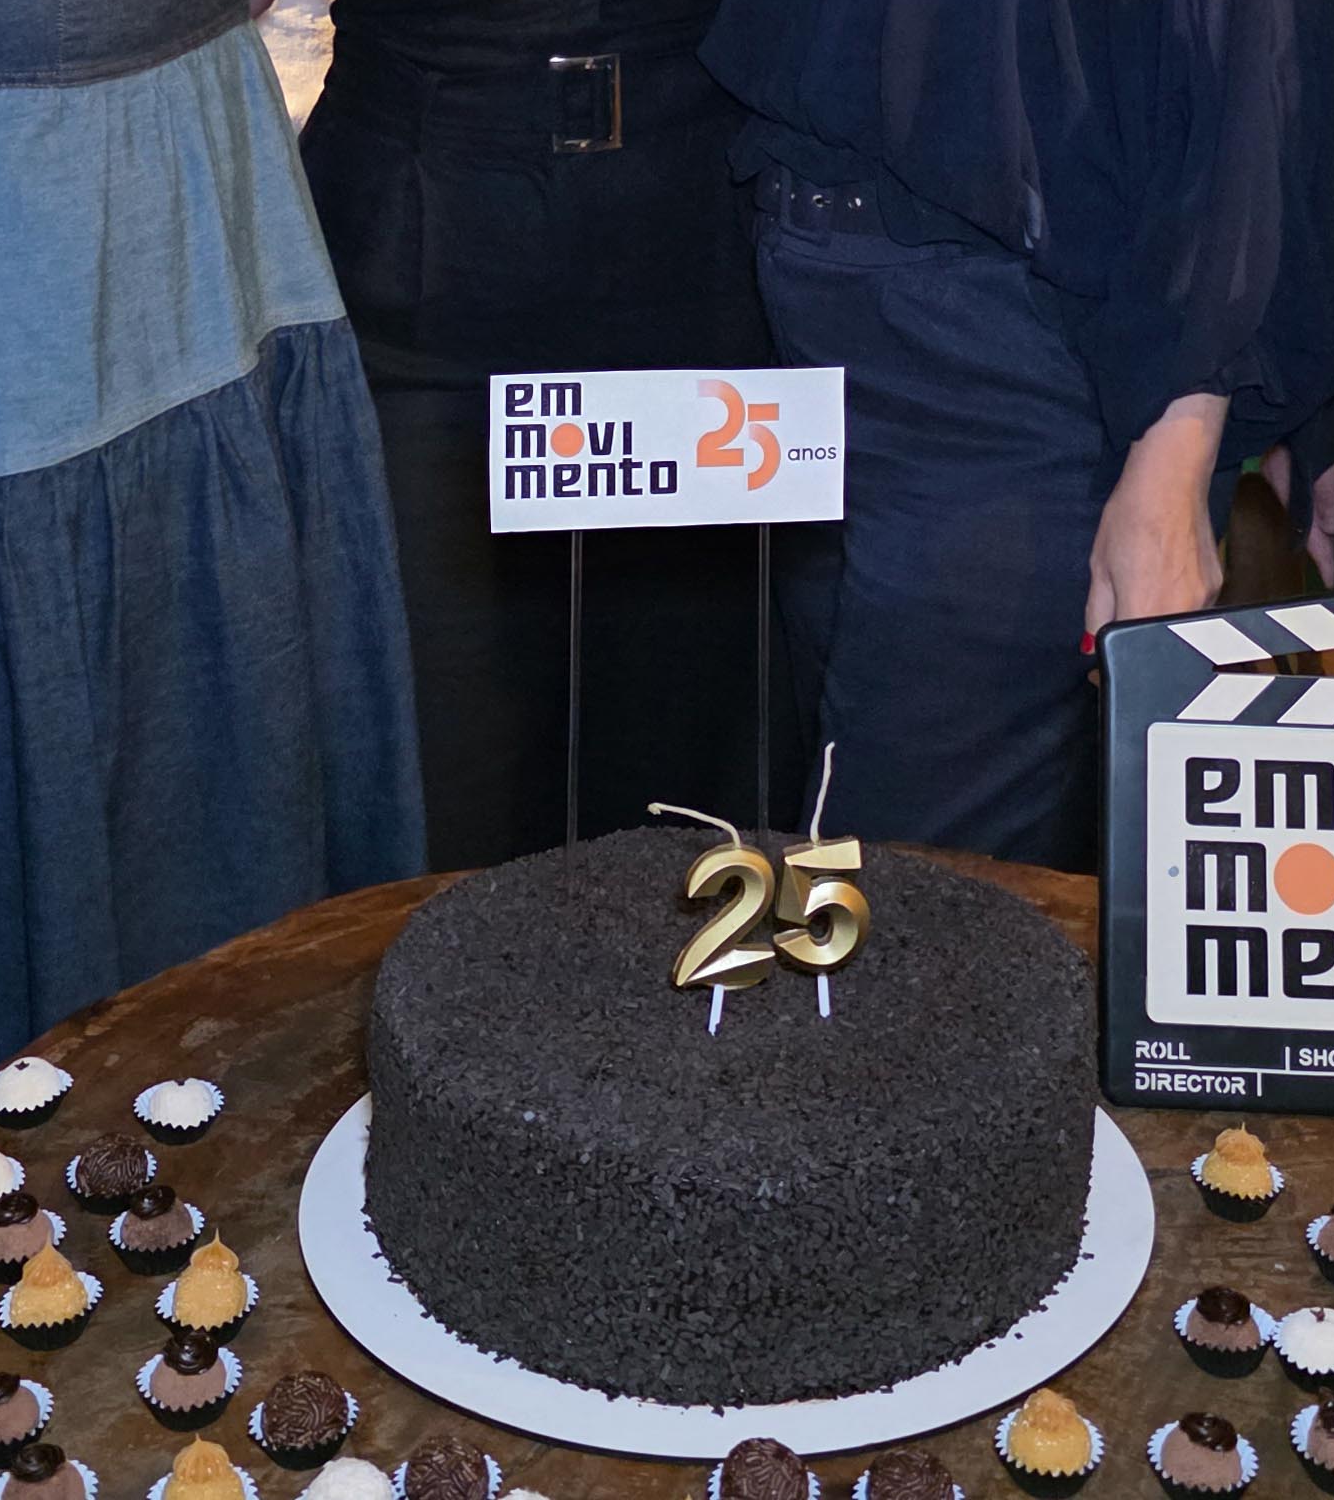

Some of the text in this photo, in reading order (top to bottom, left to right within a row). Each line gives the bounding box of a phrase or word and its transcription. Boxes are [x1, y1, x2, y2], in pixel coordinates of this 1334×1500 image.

[505, 382, 582, 417] em
[696, 379, 782, 492] 25
[787, 443, 837, 462] anos
[505, 458, 677, 499] mento
[672, 836, 871, 990] 25
[1135, 1040, 1191, 1061] ROLL
[1134, 1072, 1246, 1096] DIRECTOR
